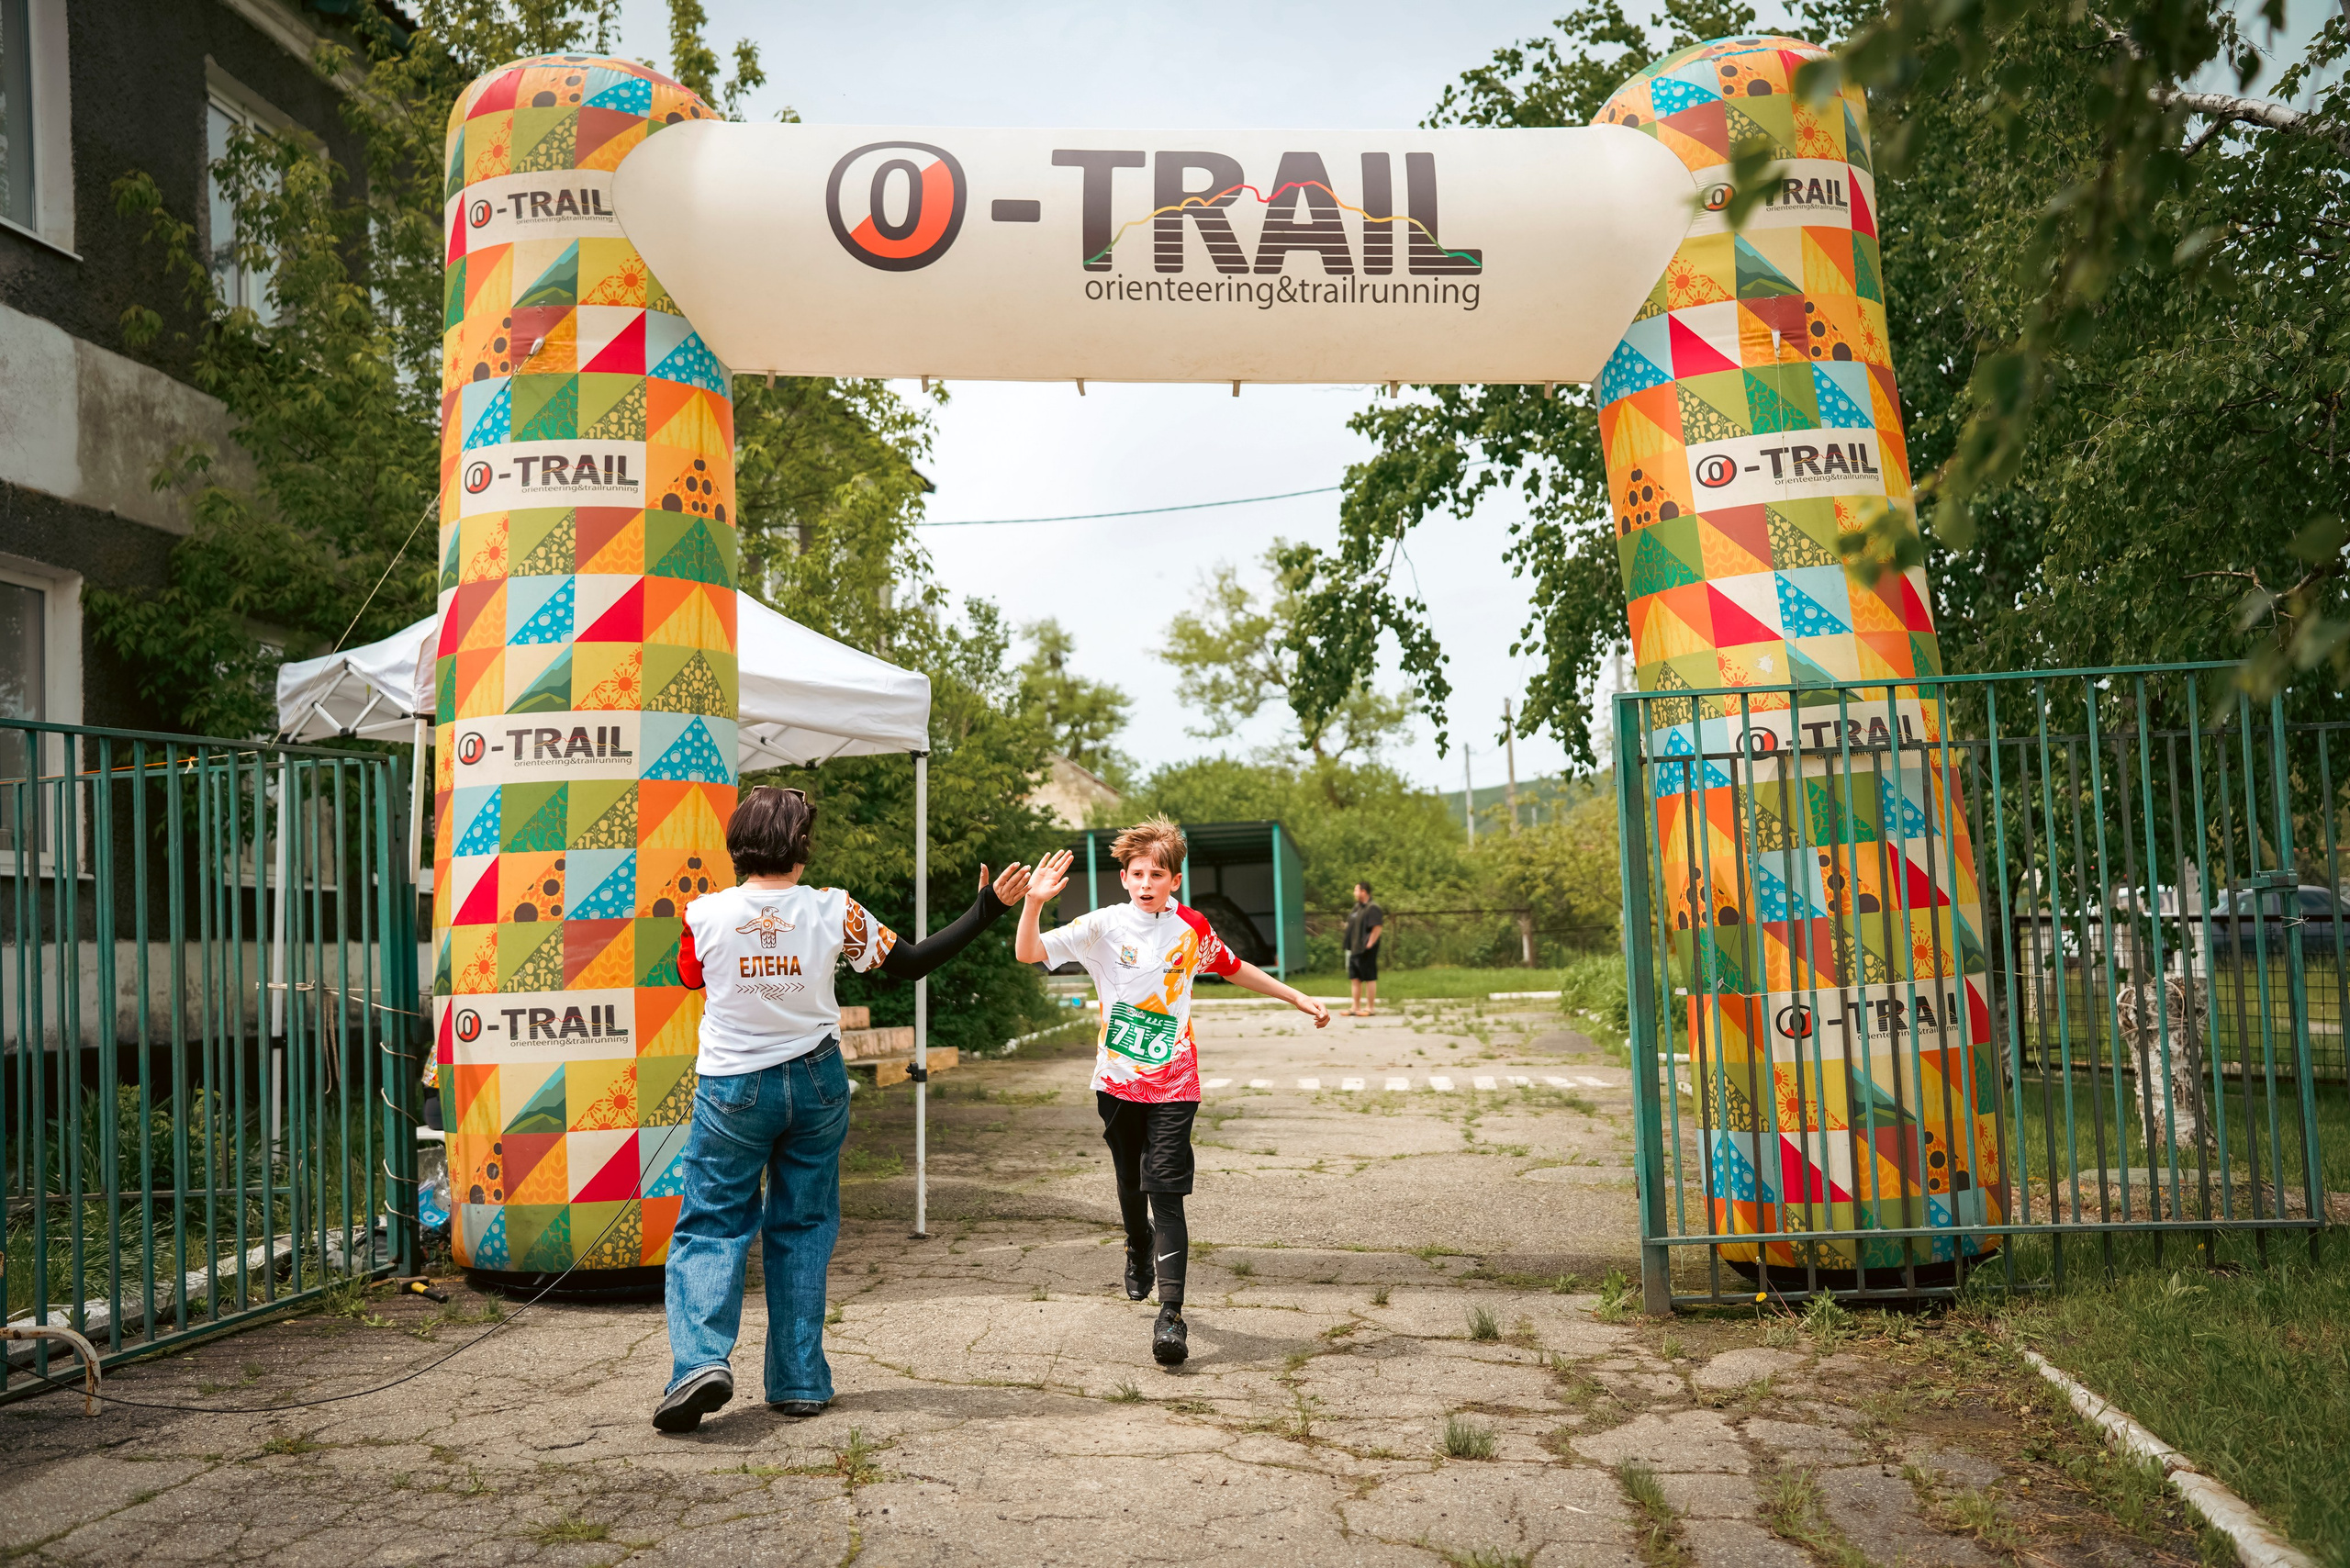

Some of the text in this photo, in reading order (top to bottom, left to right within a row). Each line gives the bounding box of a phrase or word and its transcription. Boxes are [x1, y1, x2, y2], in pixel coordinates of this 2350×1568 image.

[516, 215, 613, 225] orienteering&trailrunning
[1085, 274, 1481, 310] orienteering&trailrunning
[1774, 473, 1879, 485] orenteering&trailrunning
[521, 484, 638, 494] orienteering&trailrunning
[514, 756, 632, 767] orienteering&trailrunning
[739, 956, 802, 978] ЕЛЕНА
[509, 1035, 629, 1047] orienteering&trailrunning
[1111, 1019, 1169, 1059] 716
